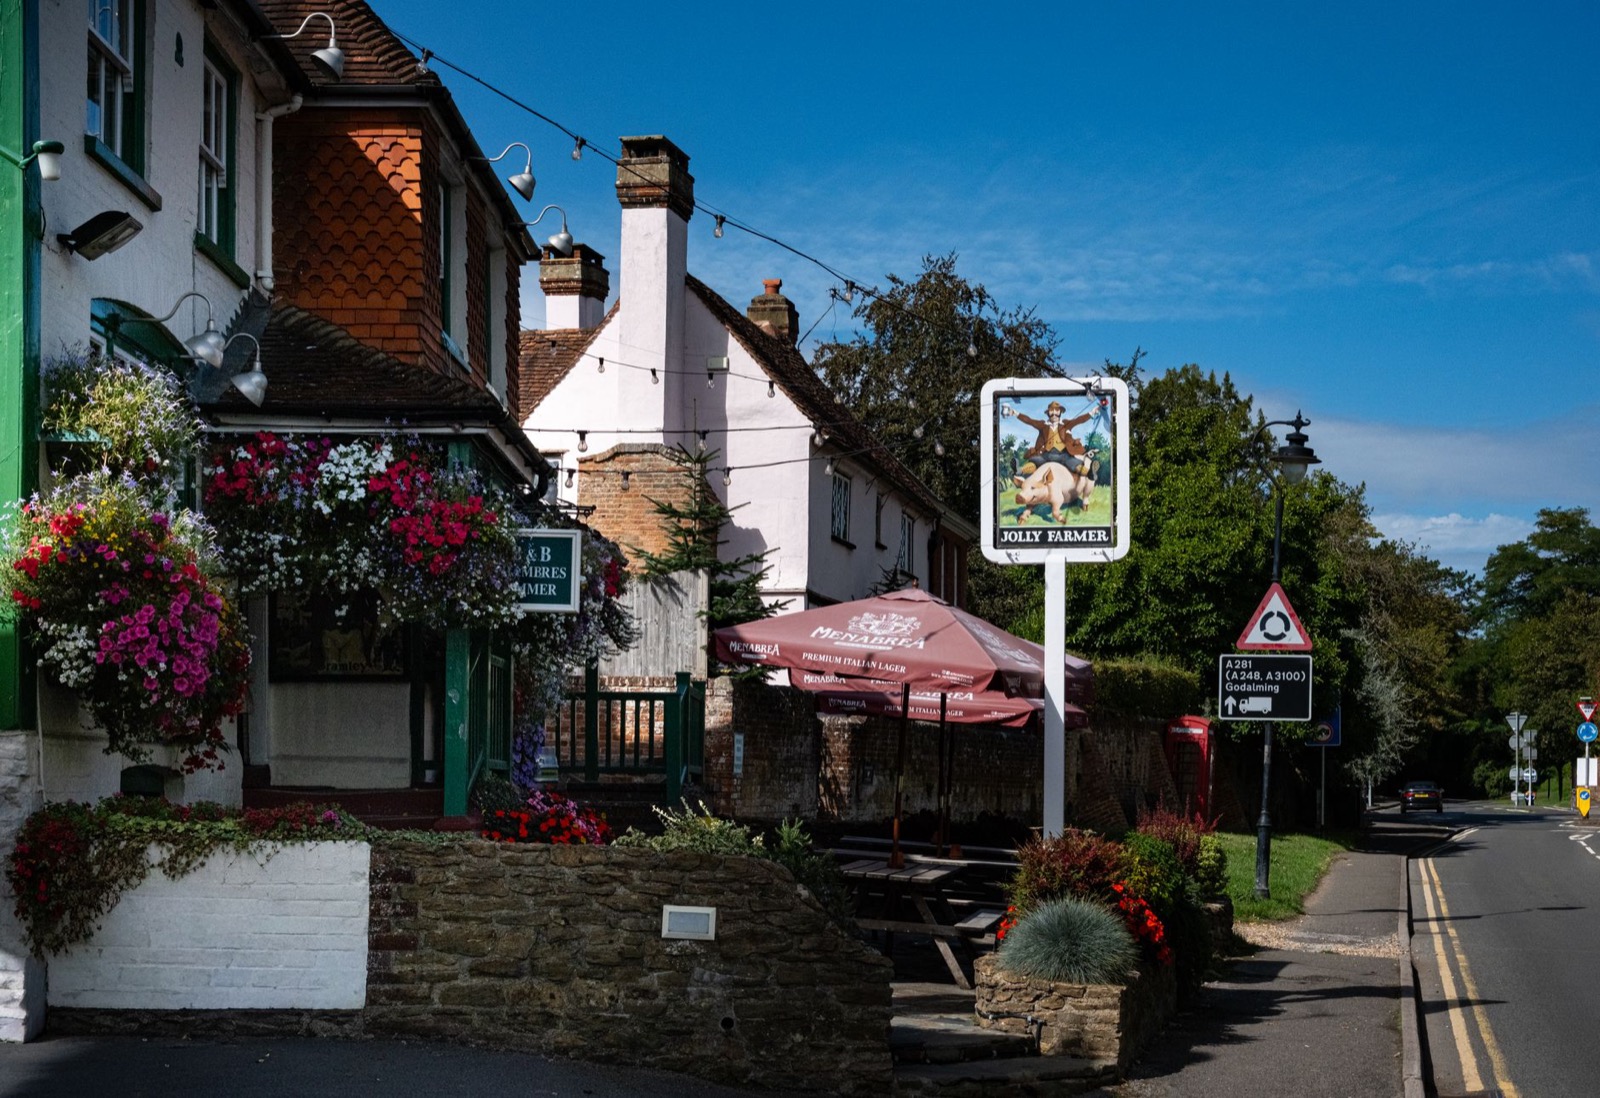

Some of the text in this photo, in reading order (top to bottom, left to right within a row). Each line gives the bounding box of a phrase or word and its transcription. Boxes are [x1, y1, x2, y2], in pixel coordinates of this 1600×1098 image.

[1001, 530, 1109, 542] JOLLY FARMER
[540, 546, 552, 562] B
[519, 566, 567, 579] MBRES
[810, 626, 925, 649] MENABREA
[729, 641, 780, 656] MENABREA
[802, 652, 906, 673] PREMIUM ITALIAN LAGER
[1225, 660, 1252, 669] A281
[1265, 670, 1306, 682] A3100)
[1225, 682, 1280, 693] Godalming
[943, 709, 963, 717] AGER
